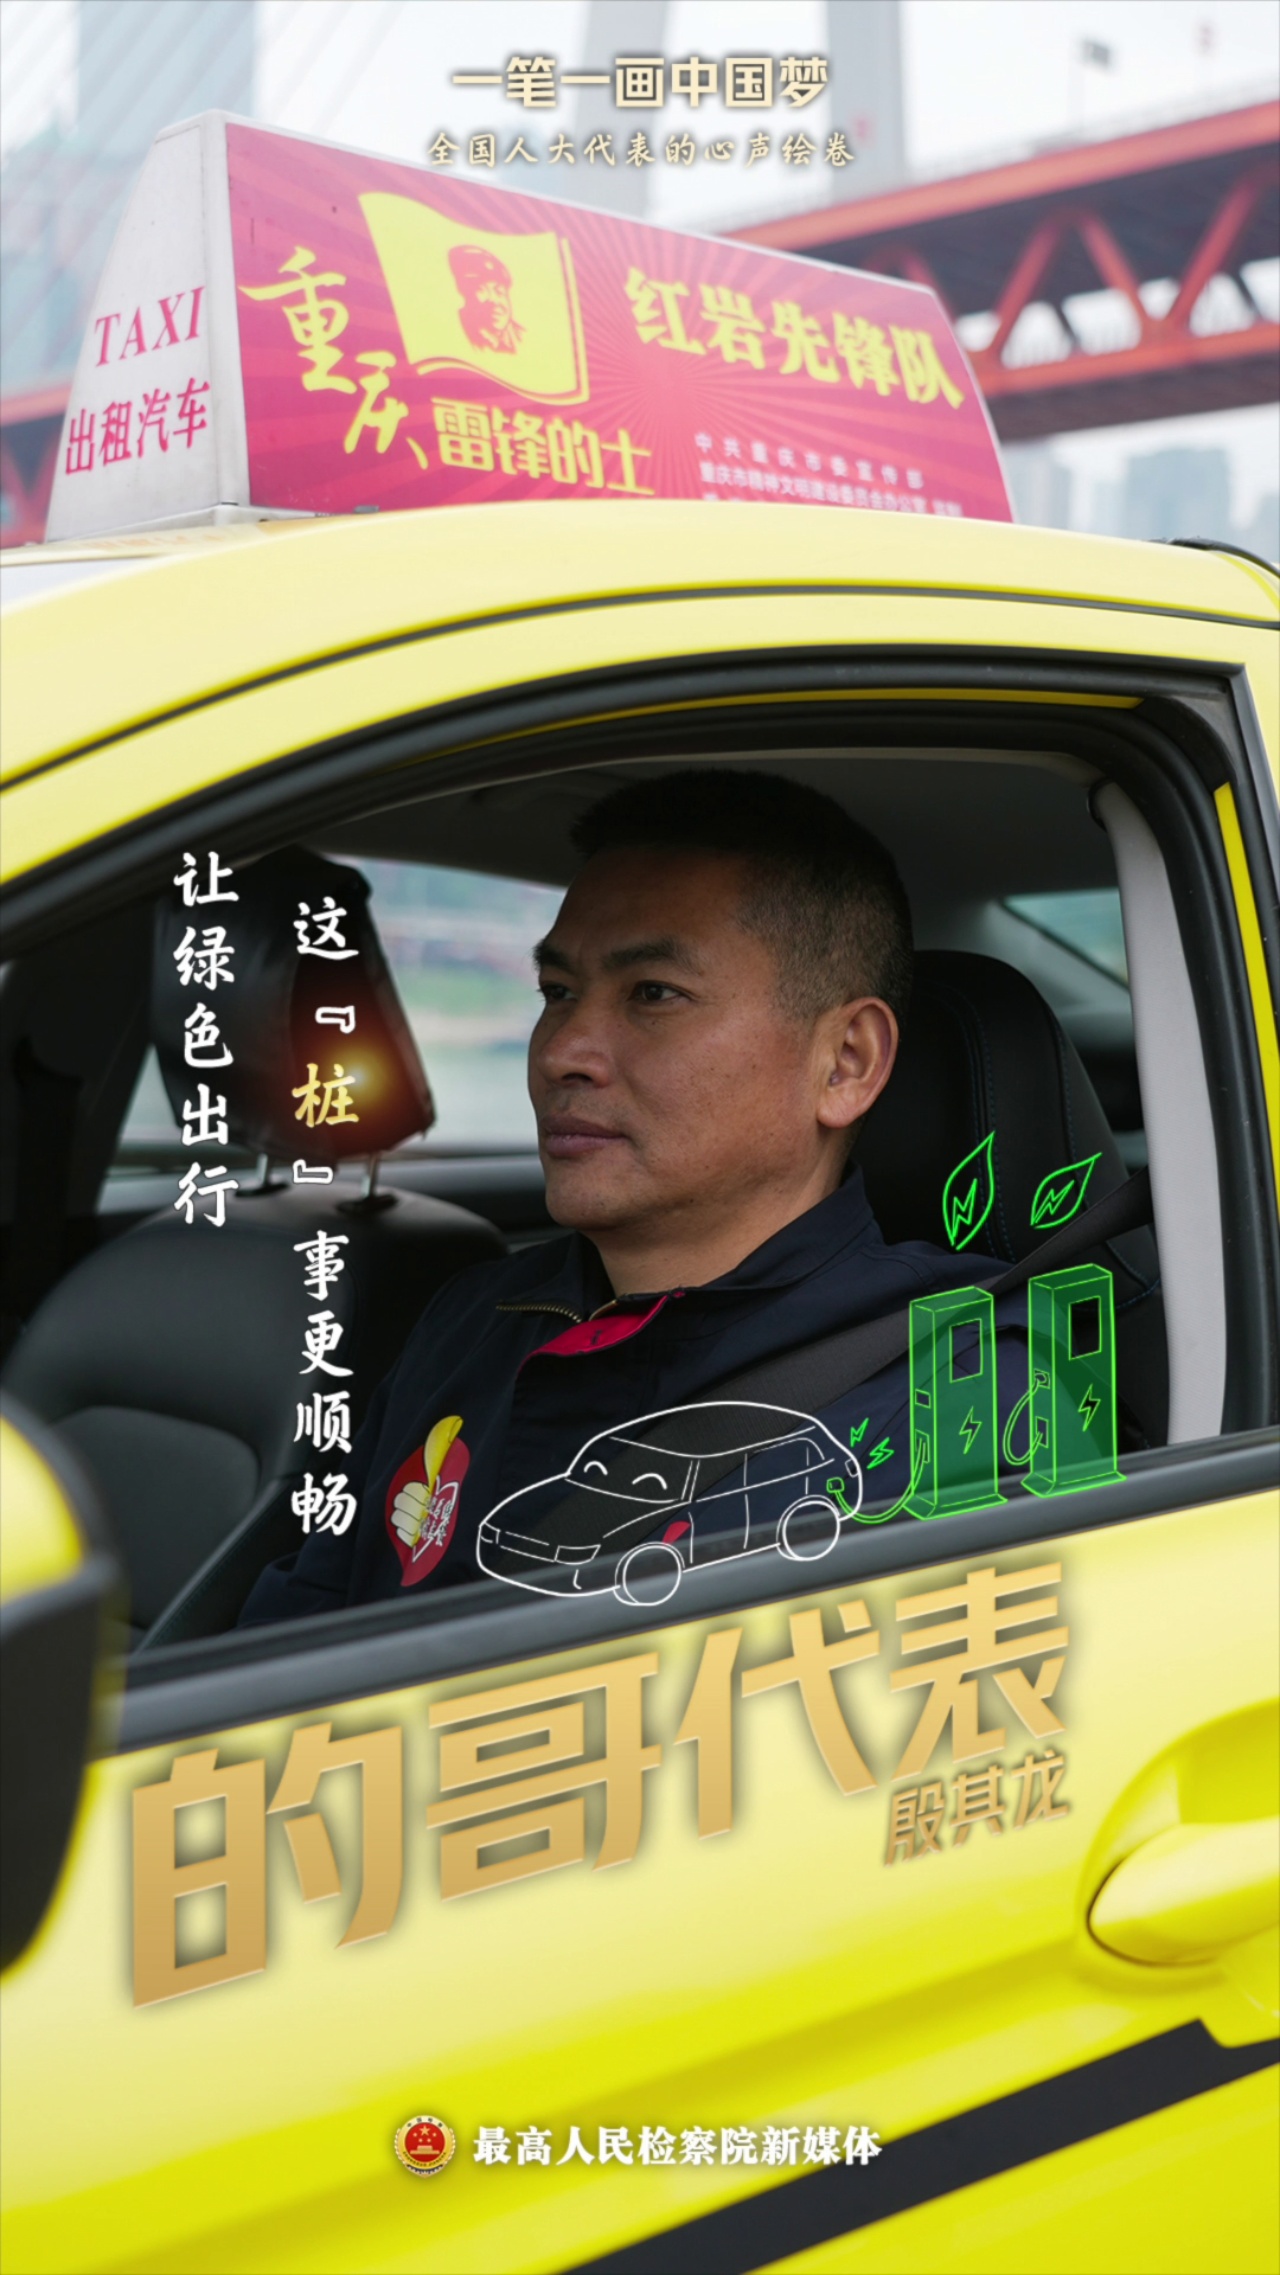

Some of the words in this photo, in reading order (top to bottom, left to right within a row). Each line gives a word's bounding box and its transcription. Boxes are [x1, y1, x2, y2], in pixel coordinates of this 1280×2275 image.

[94, 286, 204, 367] TAXI
[238, 246, 428, 470] 重庆
[625, 267, 964, 409] 红岩先锋队
[64, 377, 210, 475] 出租汽车
[432, 397, 654, 495] 雷锋的士
